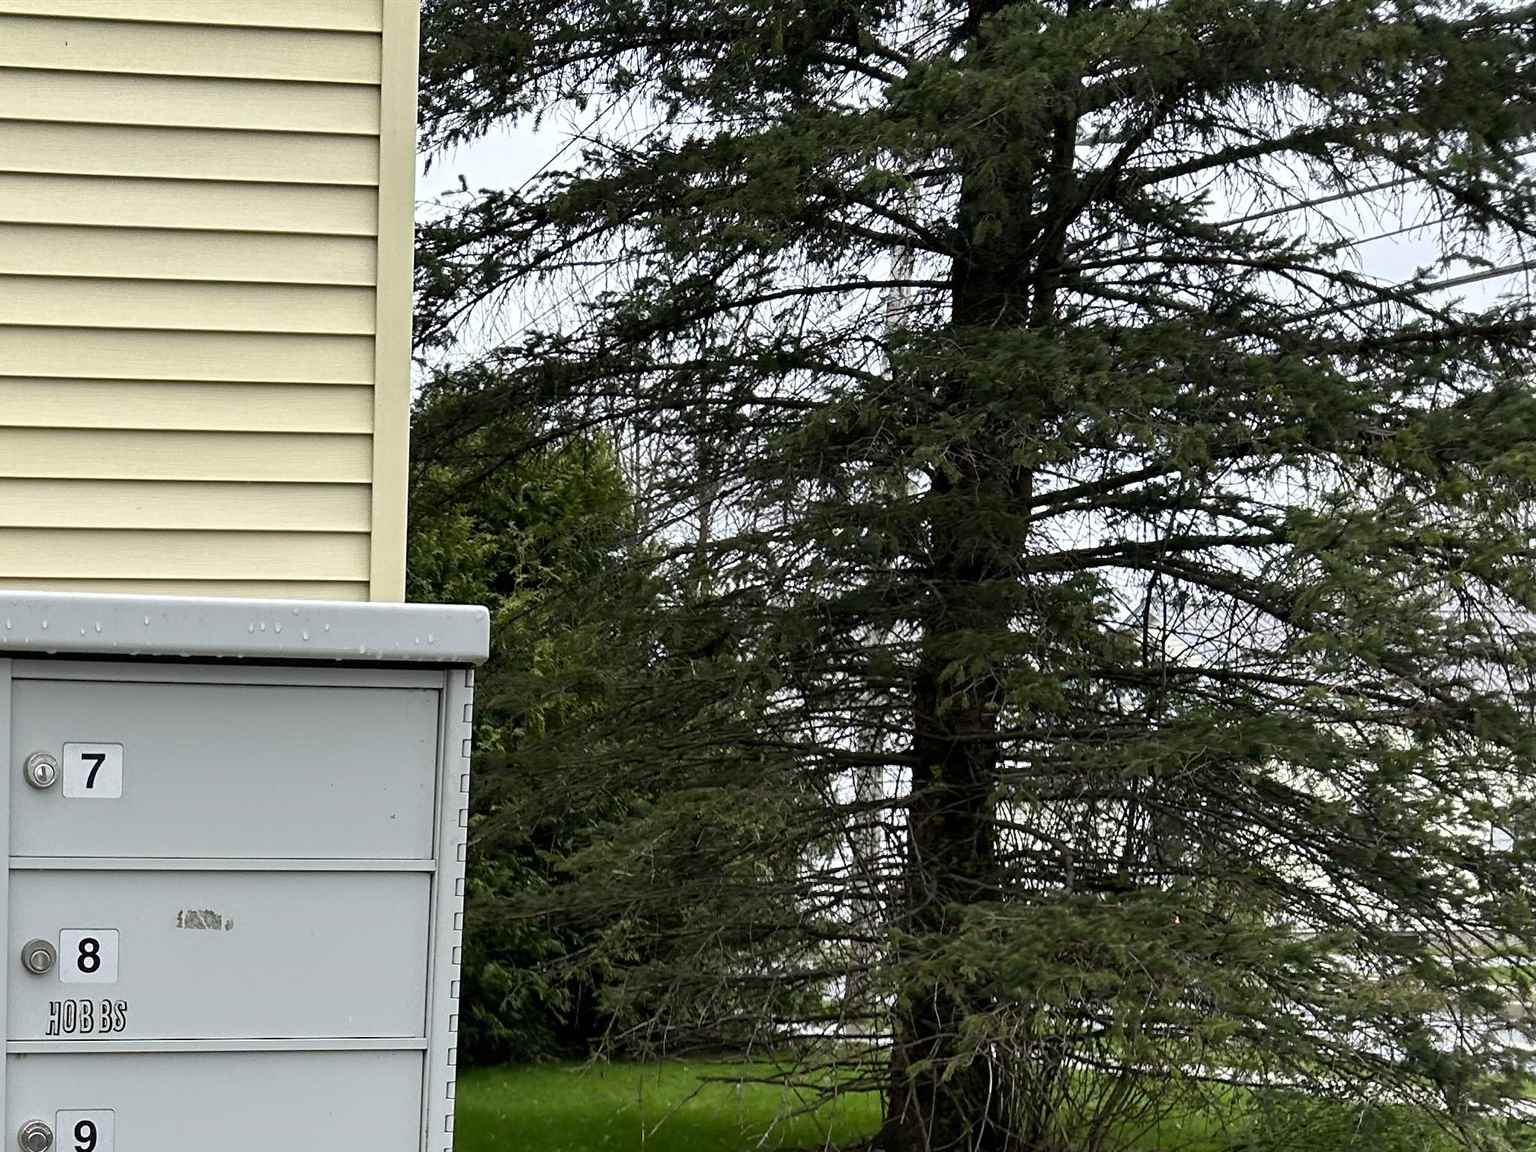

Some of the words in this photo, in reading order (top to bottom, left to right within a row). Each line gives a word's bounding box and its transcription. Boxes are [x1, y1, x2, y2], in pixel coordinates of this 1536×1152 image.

[80, 753, 106, 789] 7
[77, 937, 101, 974] 8
[45, 998, 129, 1036] HOBBS
